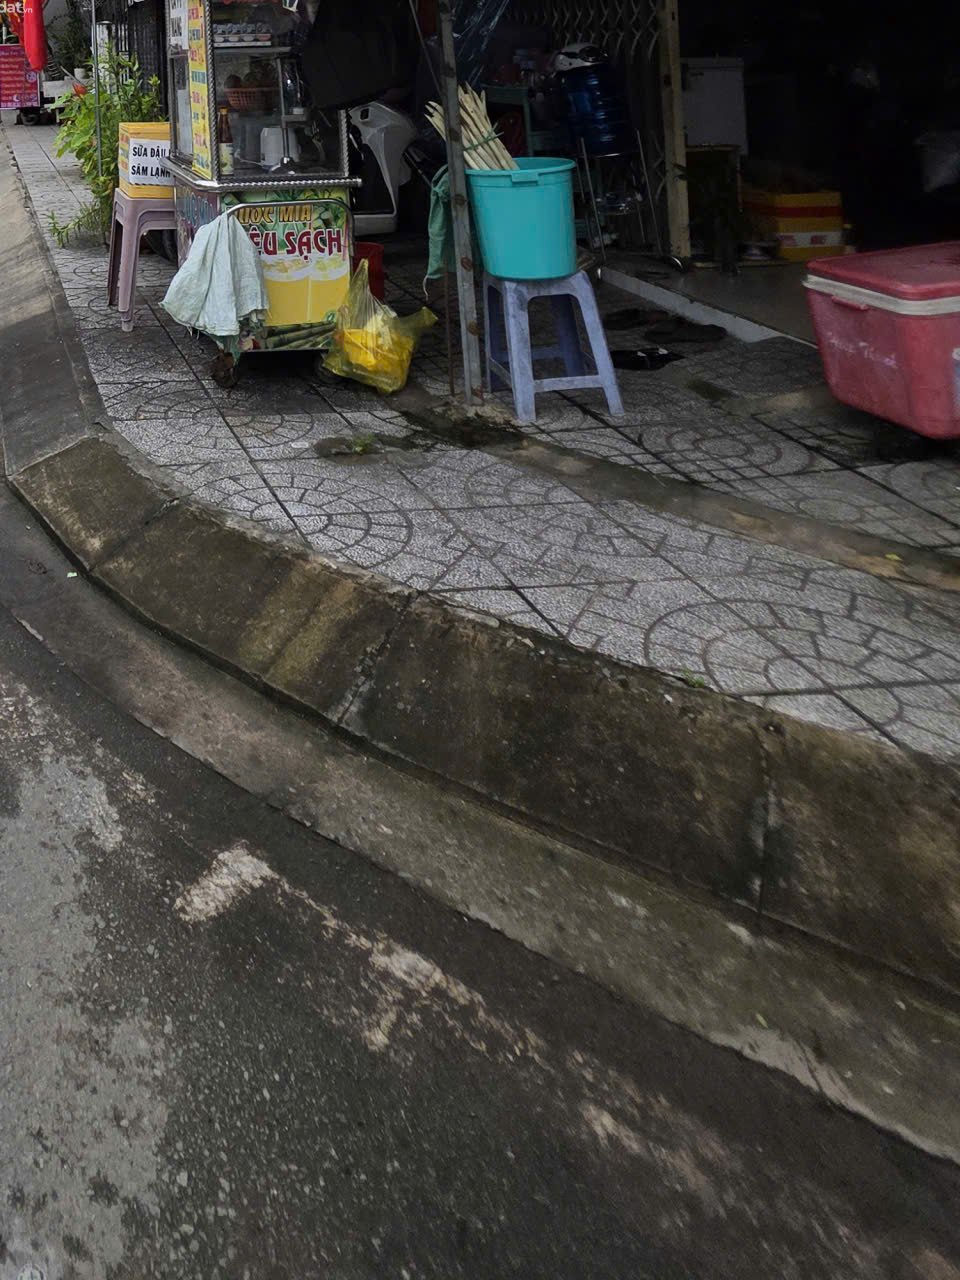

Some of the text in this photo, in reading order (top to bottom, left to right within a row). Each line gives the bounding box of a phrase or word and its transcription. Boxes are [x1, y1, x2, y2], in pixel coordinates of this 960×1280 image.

[132, 144, 148, 158] SỮA
[150, 145, 166, 160] ĐẬU
[131, 163, 171, 179] SÂM LẠNH
[284, 228, 342, 262] SẠCH
